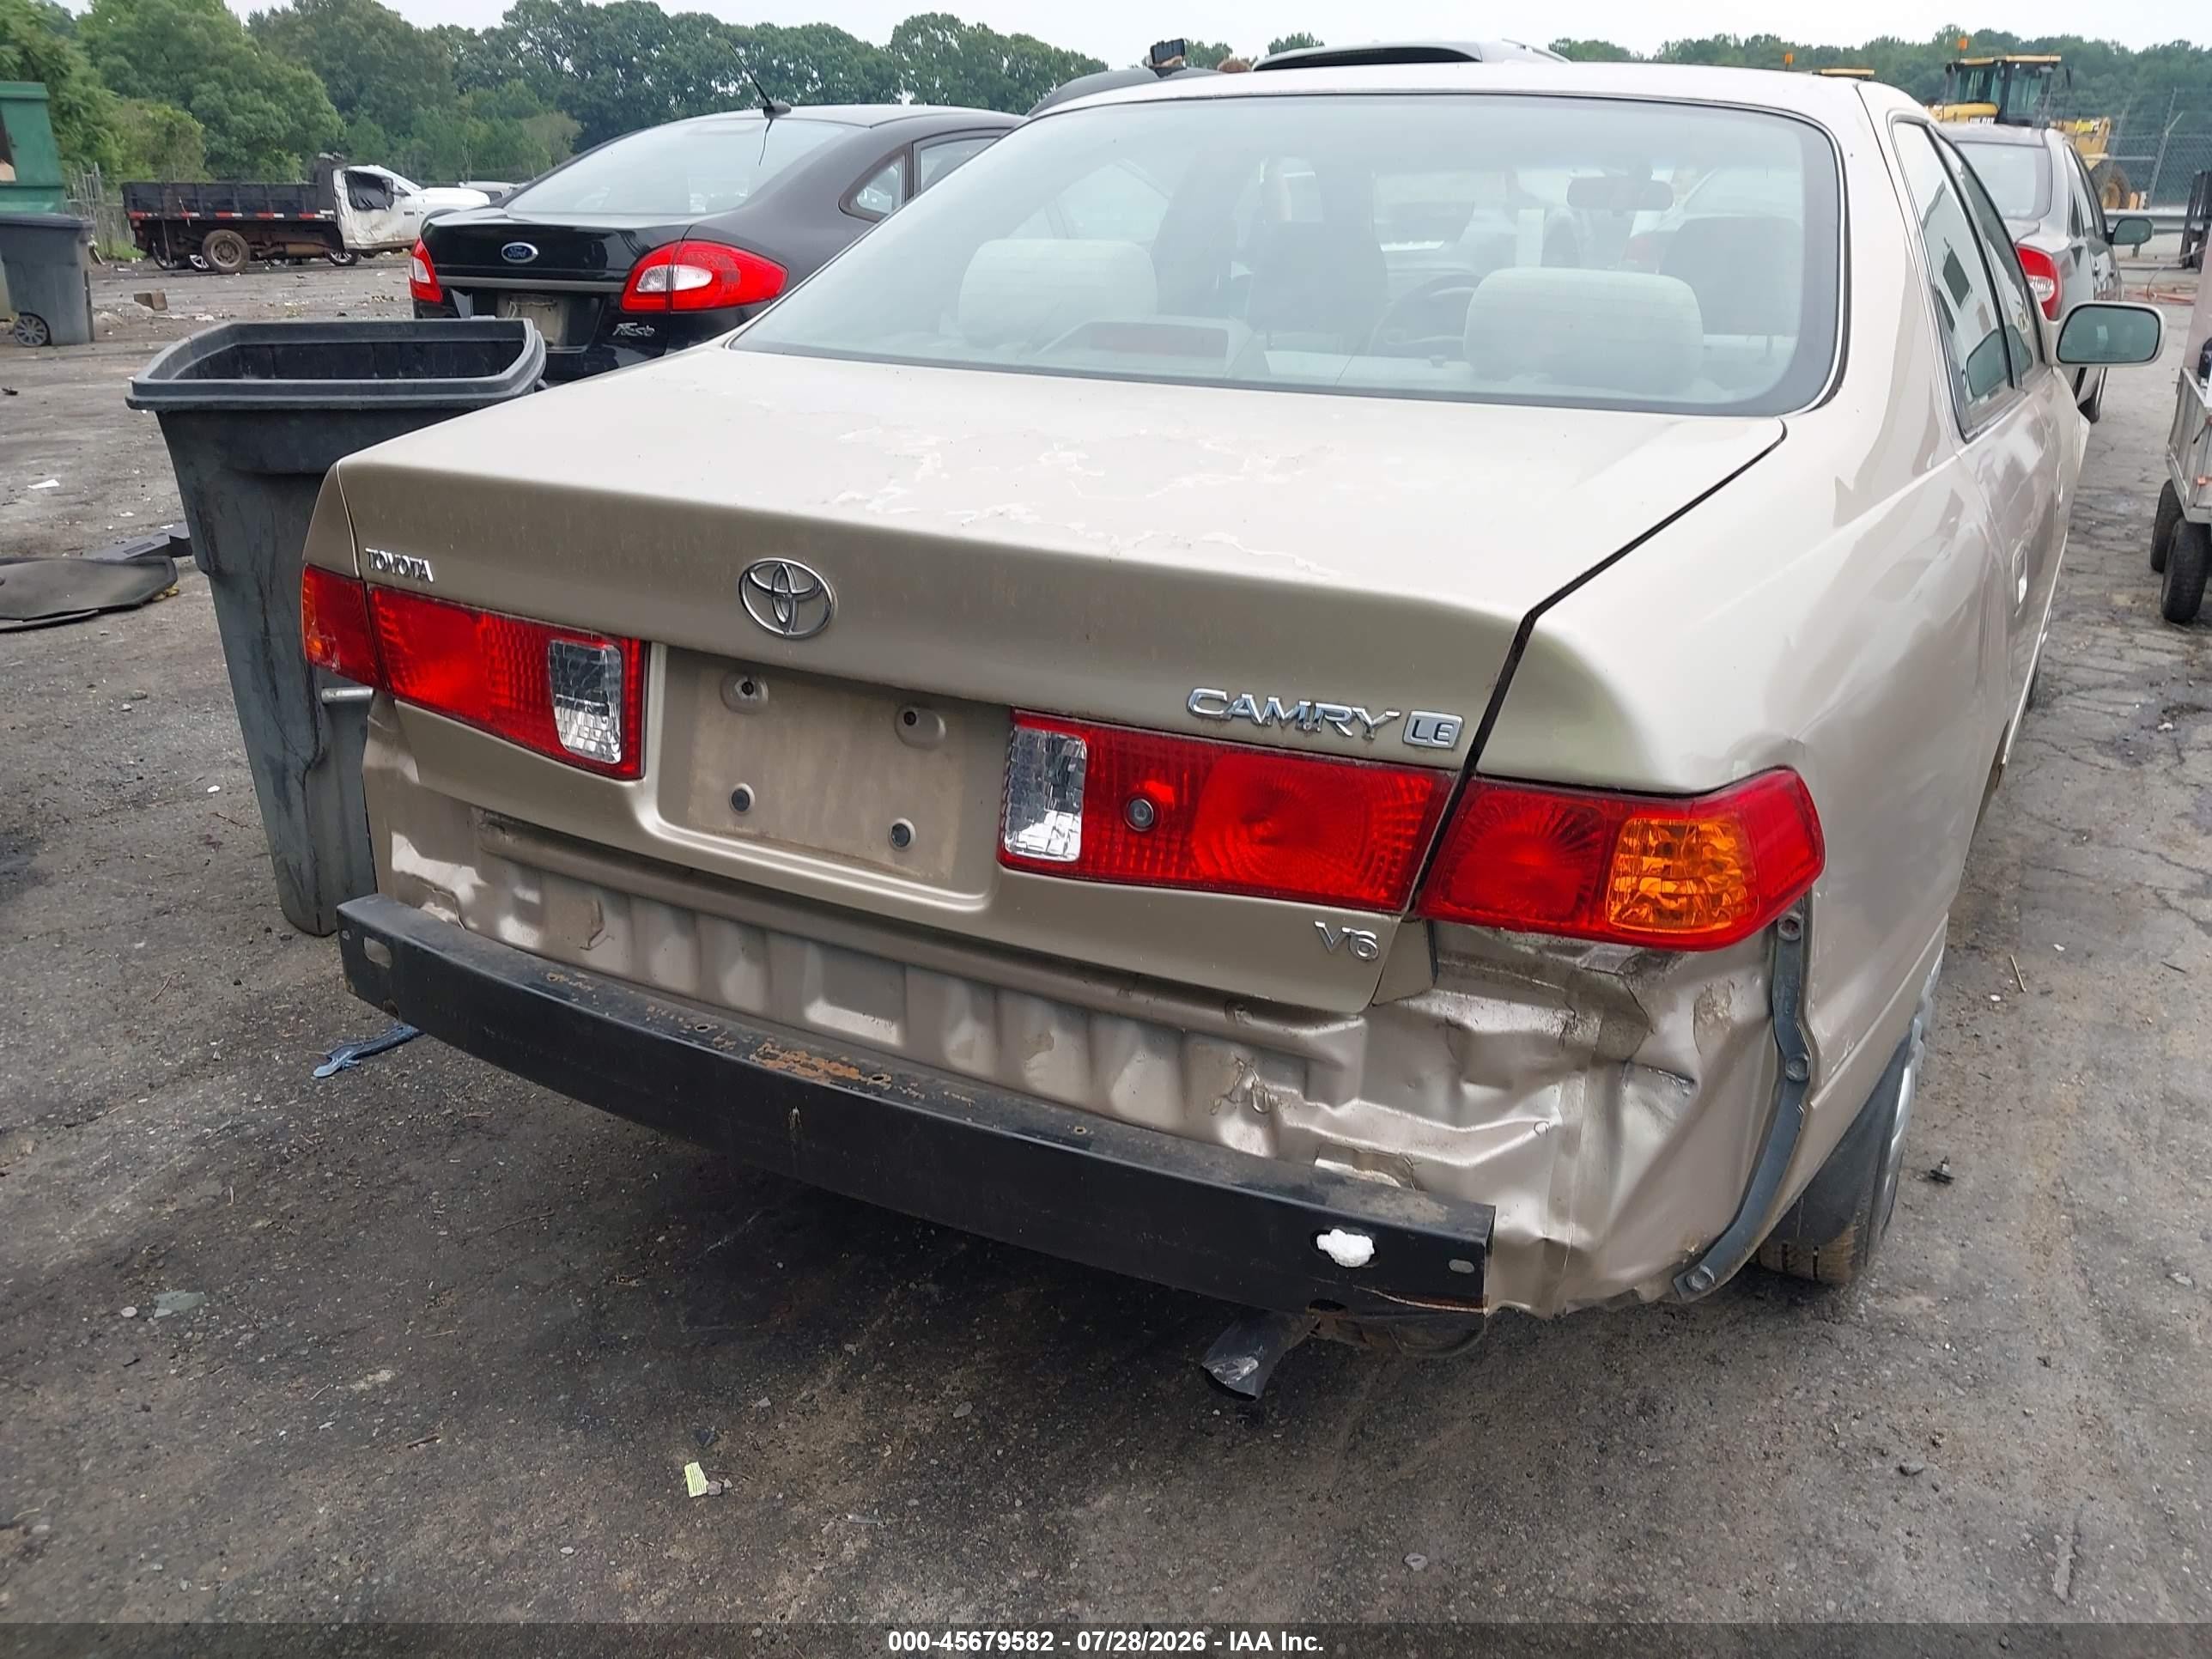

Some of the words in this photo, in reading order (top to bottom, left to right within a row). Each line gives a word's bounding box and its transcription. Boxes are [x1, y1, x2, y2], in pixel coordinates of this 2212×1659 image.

[365, 548, 434, 582] TOYOTA
[1188, 687, 1401, 740] CAMRY
[1410, 716, 1455, 747] LE
[1313, 921, 1379, 961] V6
